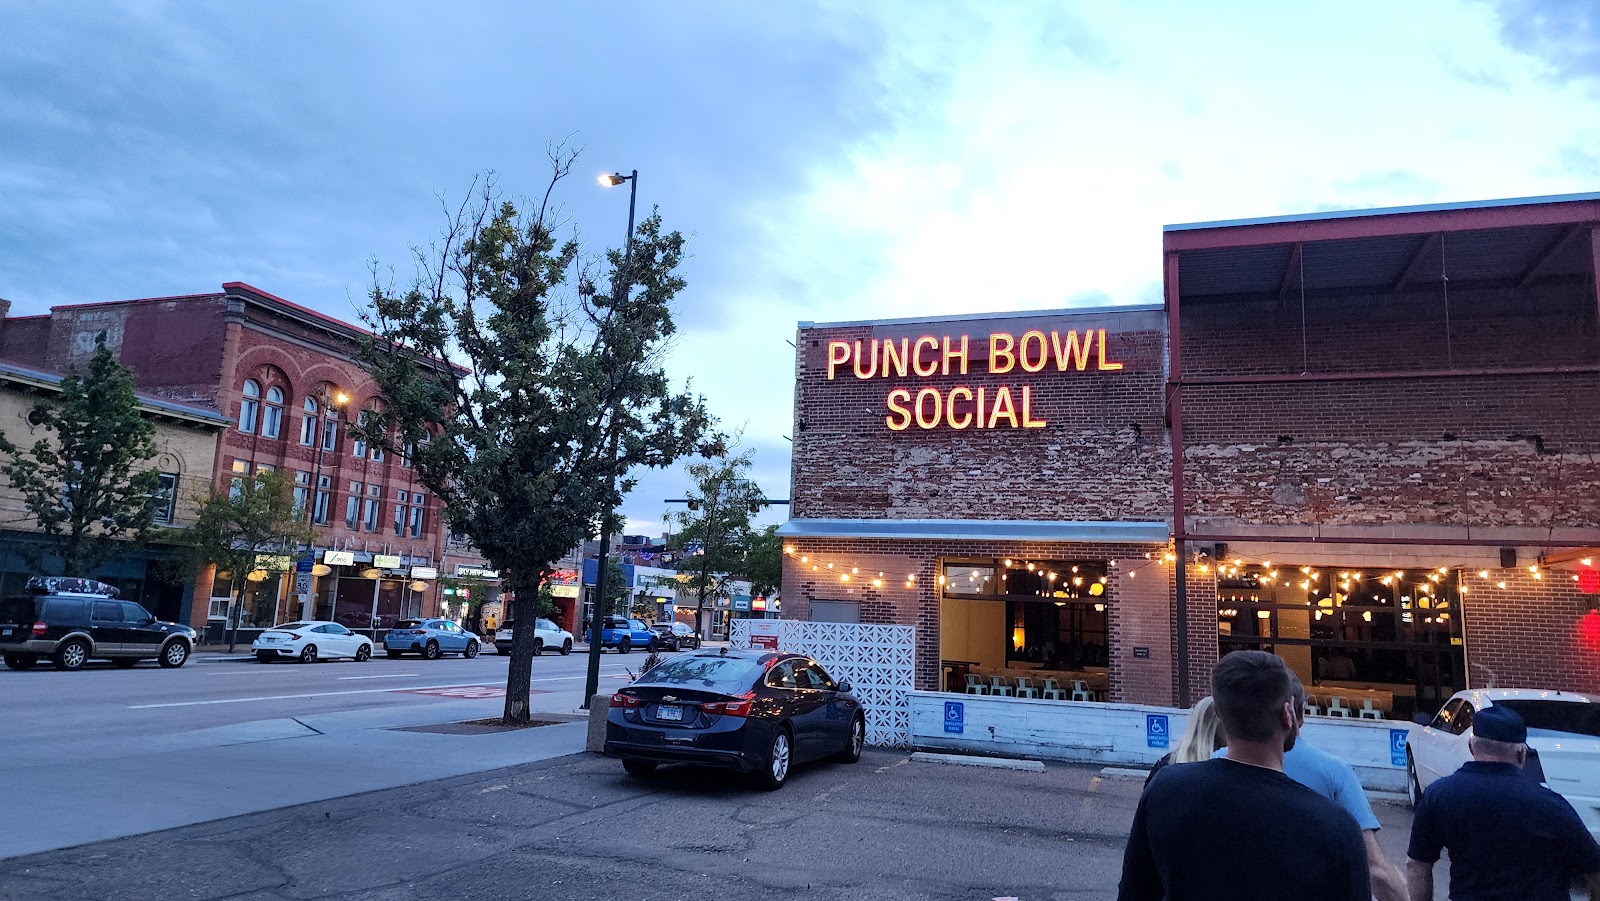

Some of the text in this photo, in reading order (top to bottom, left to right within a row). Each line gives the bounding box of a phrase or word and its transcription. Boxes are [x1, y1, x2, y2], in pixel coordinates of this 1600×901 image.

[827, 328, 1124, 380] PUNCH BOWL
[885, 386, 1047, 431] SOCIAL
